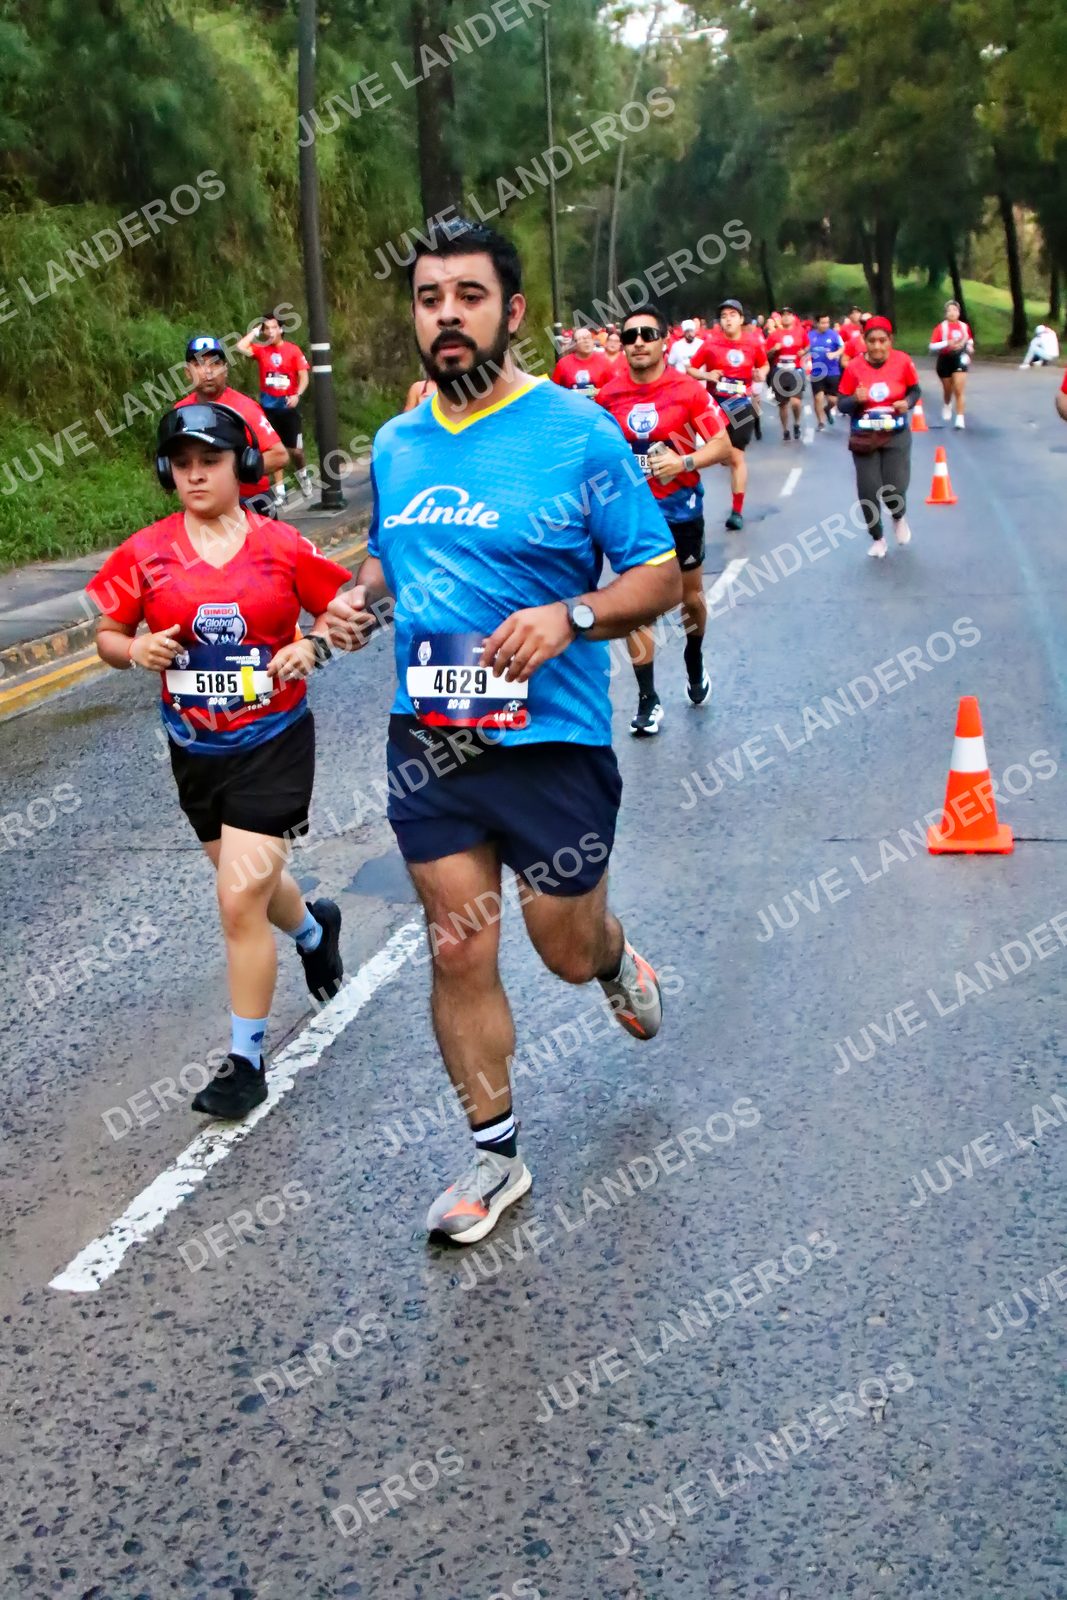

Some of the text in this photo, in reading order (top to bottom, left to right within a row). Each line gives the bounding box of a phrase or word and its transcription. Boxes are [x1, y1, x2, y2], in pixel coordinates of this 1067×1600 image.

[384, 485, 499, 529] Linde
[203, 608, 234, 616] BIMBO
[205, 617, 235, 628] Global
[196, 673, 237, 693] 5185
[434, 669, 487, 694] 4629
[493, 713, 514, 722] 10K
